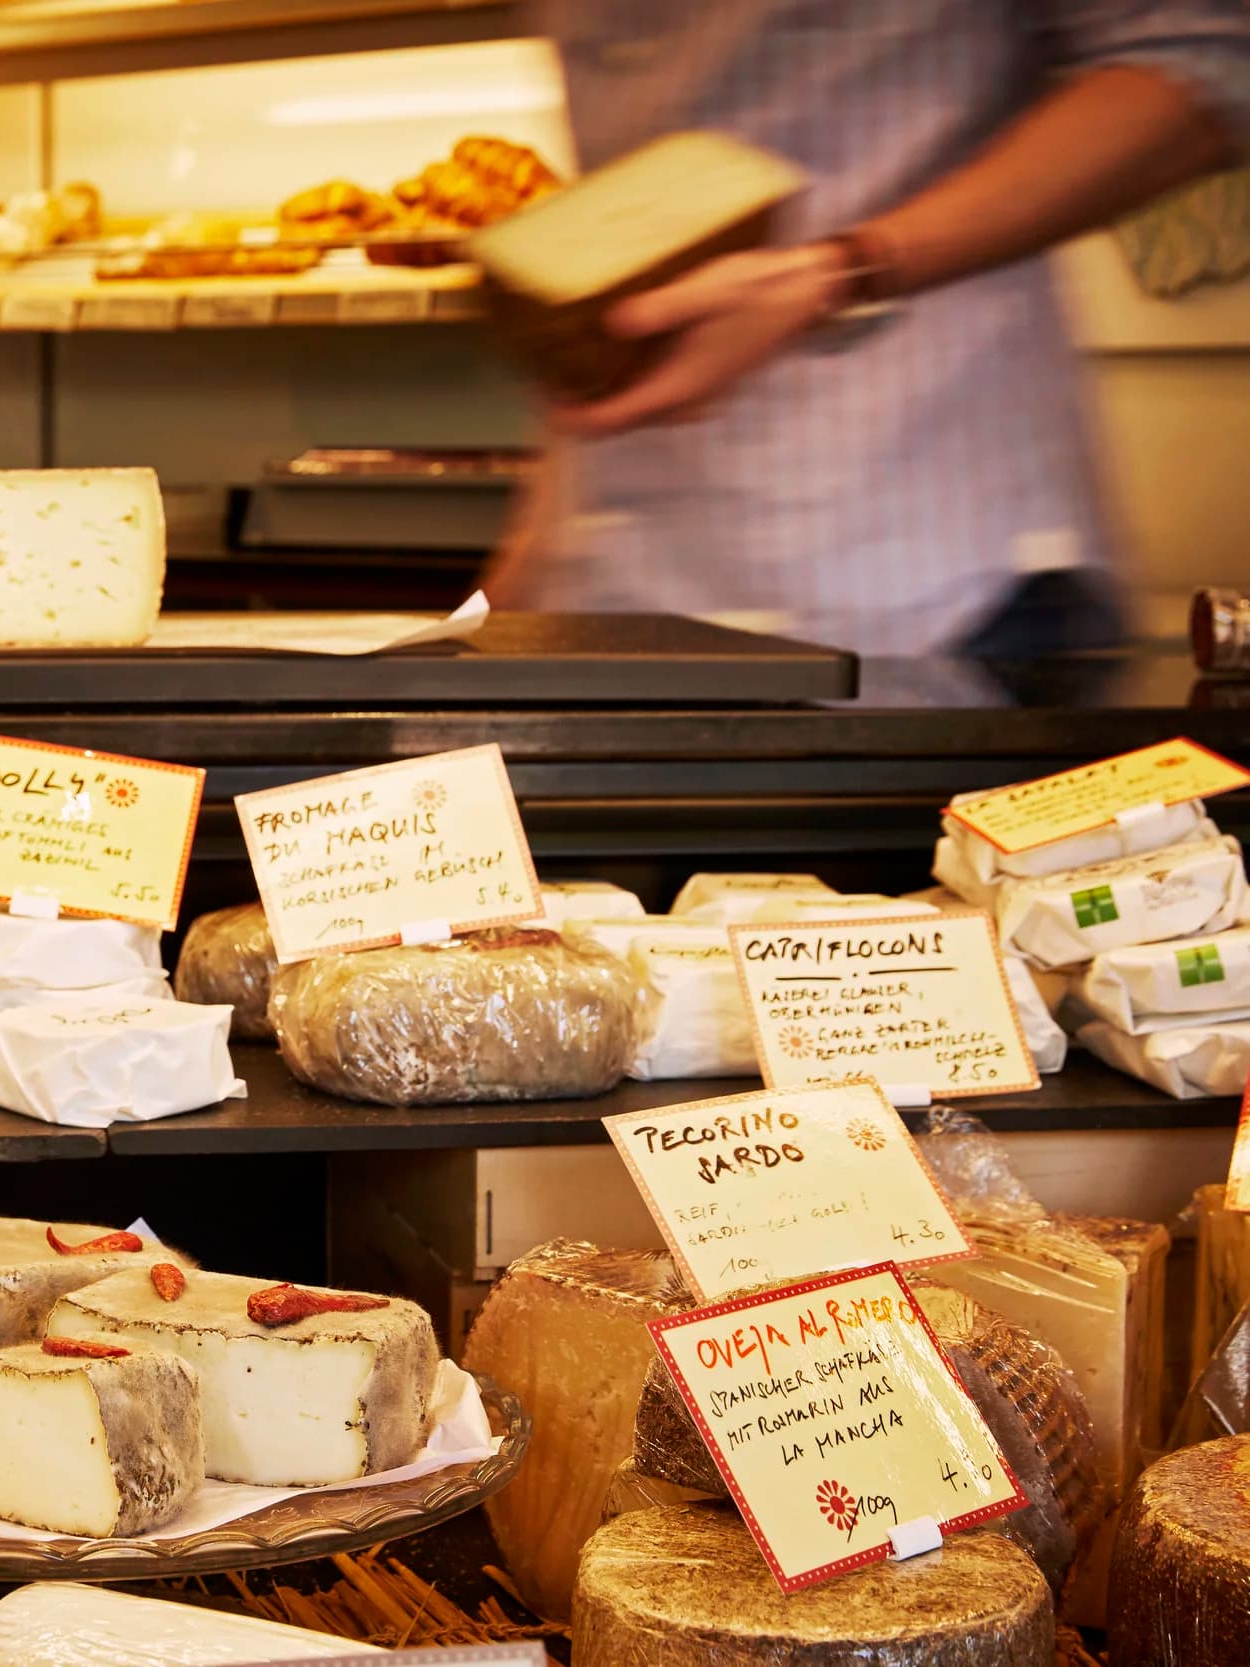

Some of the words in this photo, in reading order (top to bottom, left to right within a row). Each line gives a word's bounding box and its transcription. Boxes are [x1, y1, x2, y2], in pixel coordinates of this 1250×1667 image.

[254, 792, 379, 834] FROMAGE
[264, 839, 301, 863] DU
[326, 813, 439, 854] MAQUIS
[633, 1107, 799, 1154] PECORINO
[697, 1142, 805, 1184] SARDO
[890, 1220, 945, 1247] 4.30
[696, 1323, 790, 1374] OVEJA
[796, 1309, 827, 1346] AL
[709, 1368, 813, 1418] SPANISCHER
[727, 1423, 752, 1450] MIT
[757, 1394, 844, 1437] ROSMARIN
[860, 1376, 894, 1407] AUS
[782, 1442, 805, 1466] LA
[815, 1410, 904, 1458] MANCHA
[937, 1456, 991, 1492] 4.0
[847, 1496, 898, 1543] 100g
